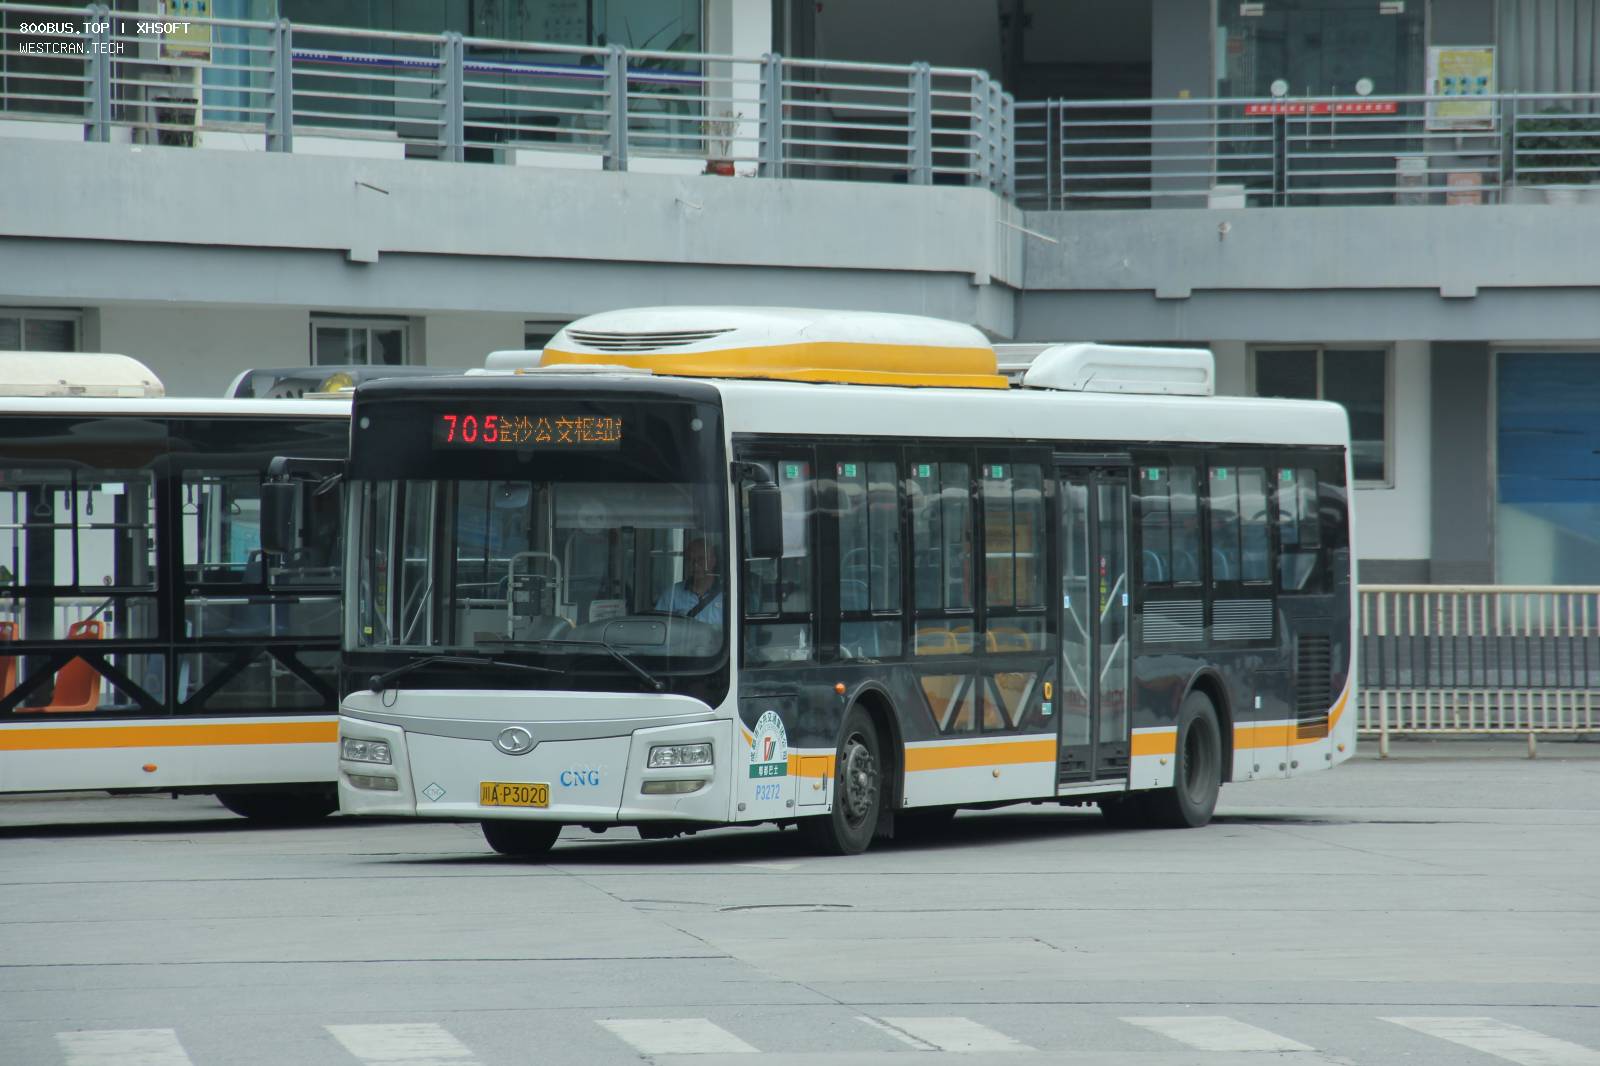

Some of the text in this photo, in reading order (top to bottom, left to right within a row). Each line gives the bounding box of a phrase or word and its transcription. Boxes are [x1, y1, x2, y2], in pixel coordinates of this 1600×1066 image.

[443, 415, 498, 442] 705
[559, 770, 600, 788] CNG
[755, 783, 781, 801] P3272
